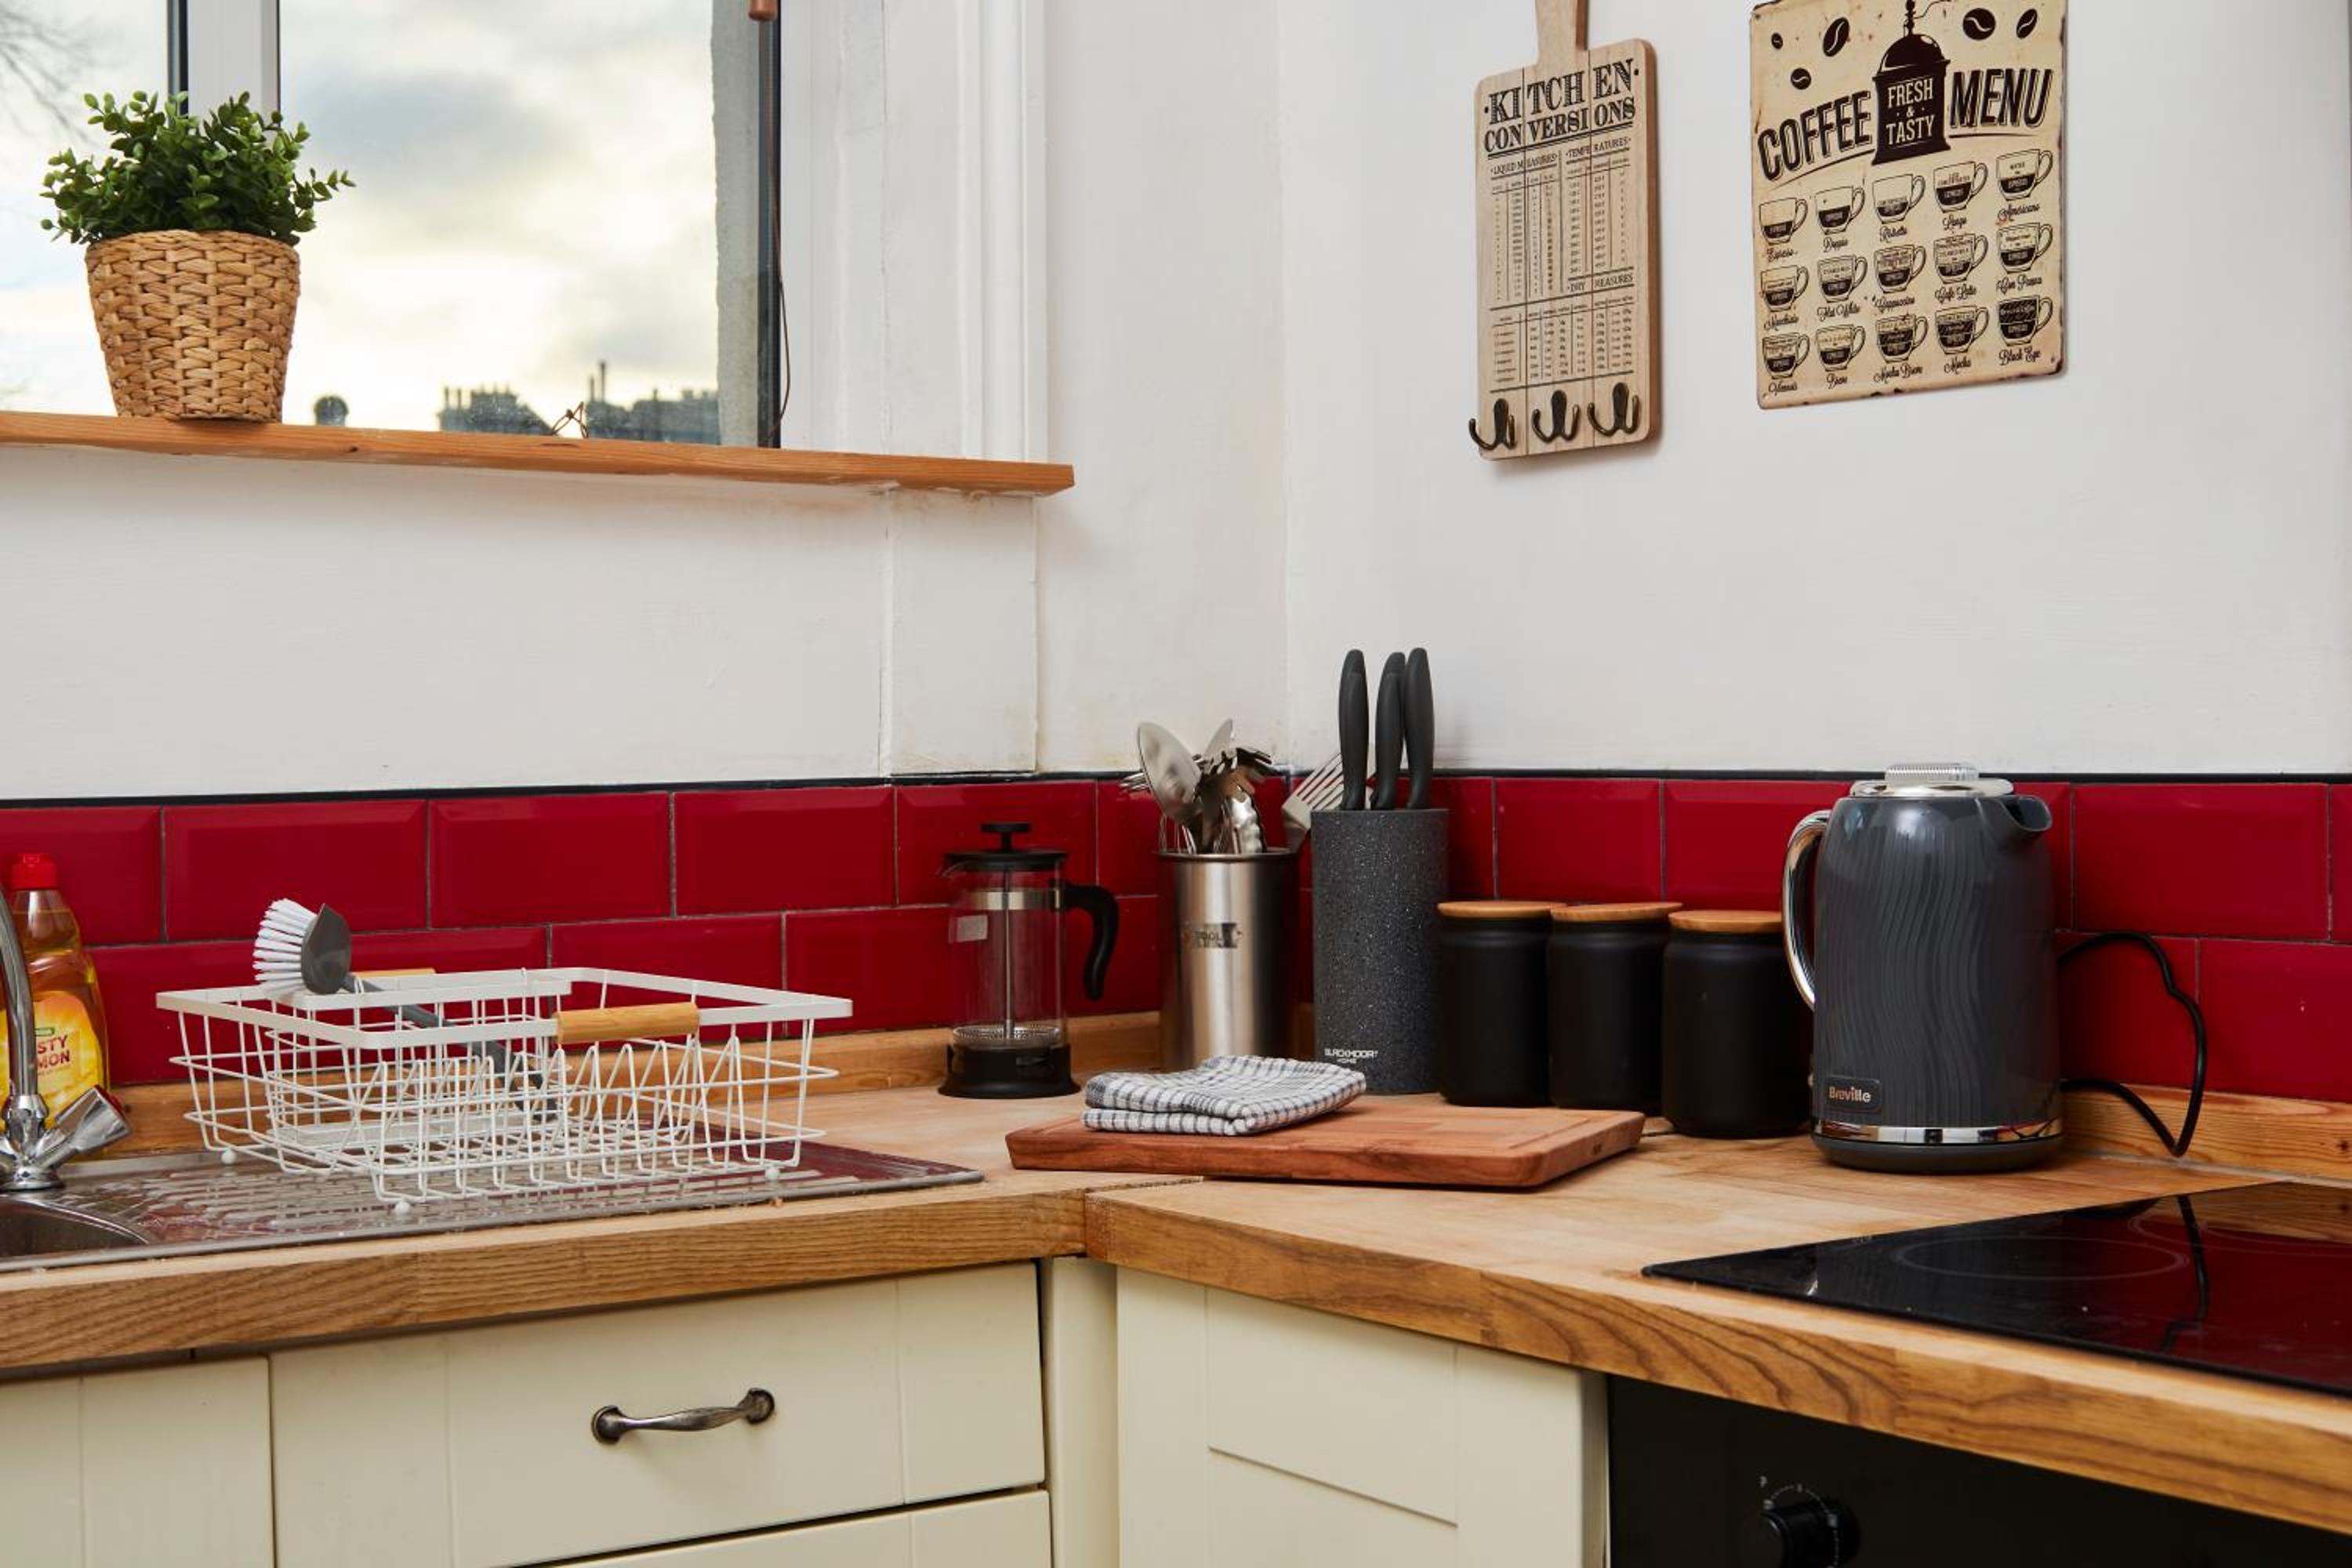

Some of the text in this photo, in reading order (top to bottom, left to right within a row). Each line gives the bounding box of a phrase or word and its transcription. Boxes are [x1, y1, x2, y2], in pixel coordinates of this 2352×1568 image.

[1887, 78, 1934, 109] FRESH
[1949, 68, 2054, 129] MENU
[1484, 96, 1636, 153] CONVERSIONS
[1906, 106, 1915, 118] &
[1757, 90, 1873, 181] COFFEE
[1886, 114, 1935, 145] TASTY
[37, 1050, 70, 1069] MON
[38, 1034, 68, 1054] STY
[1829, 1086, 1871, 1103] Breville
